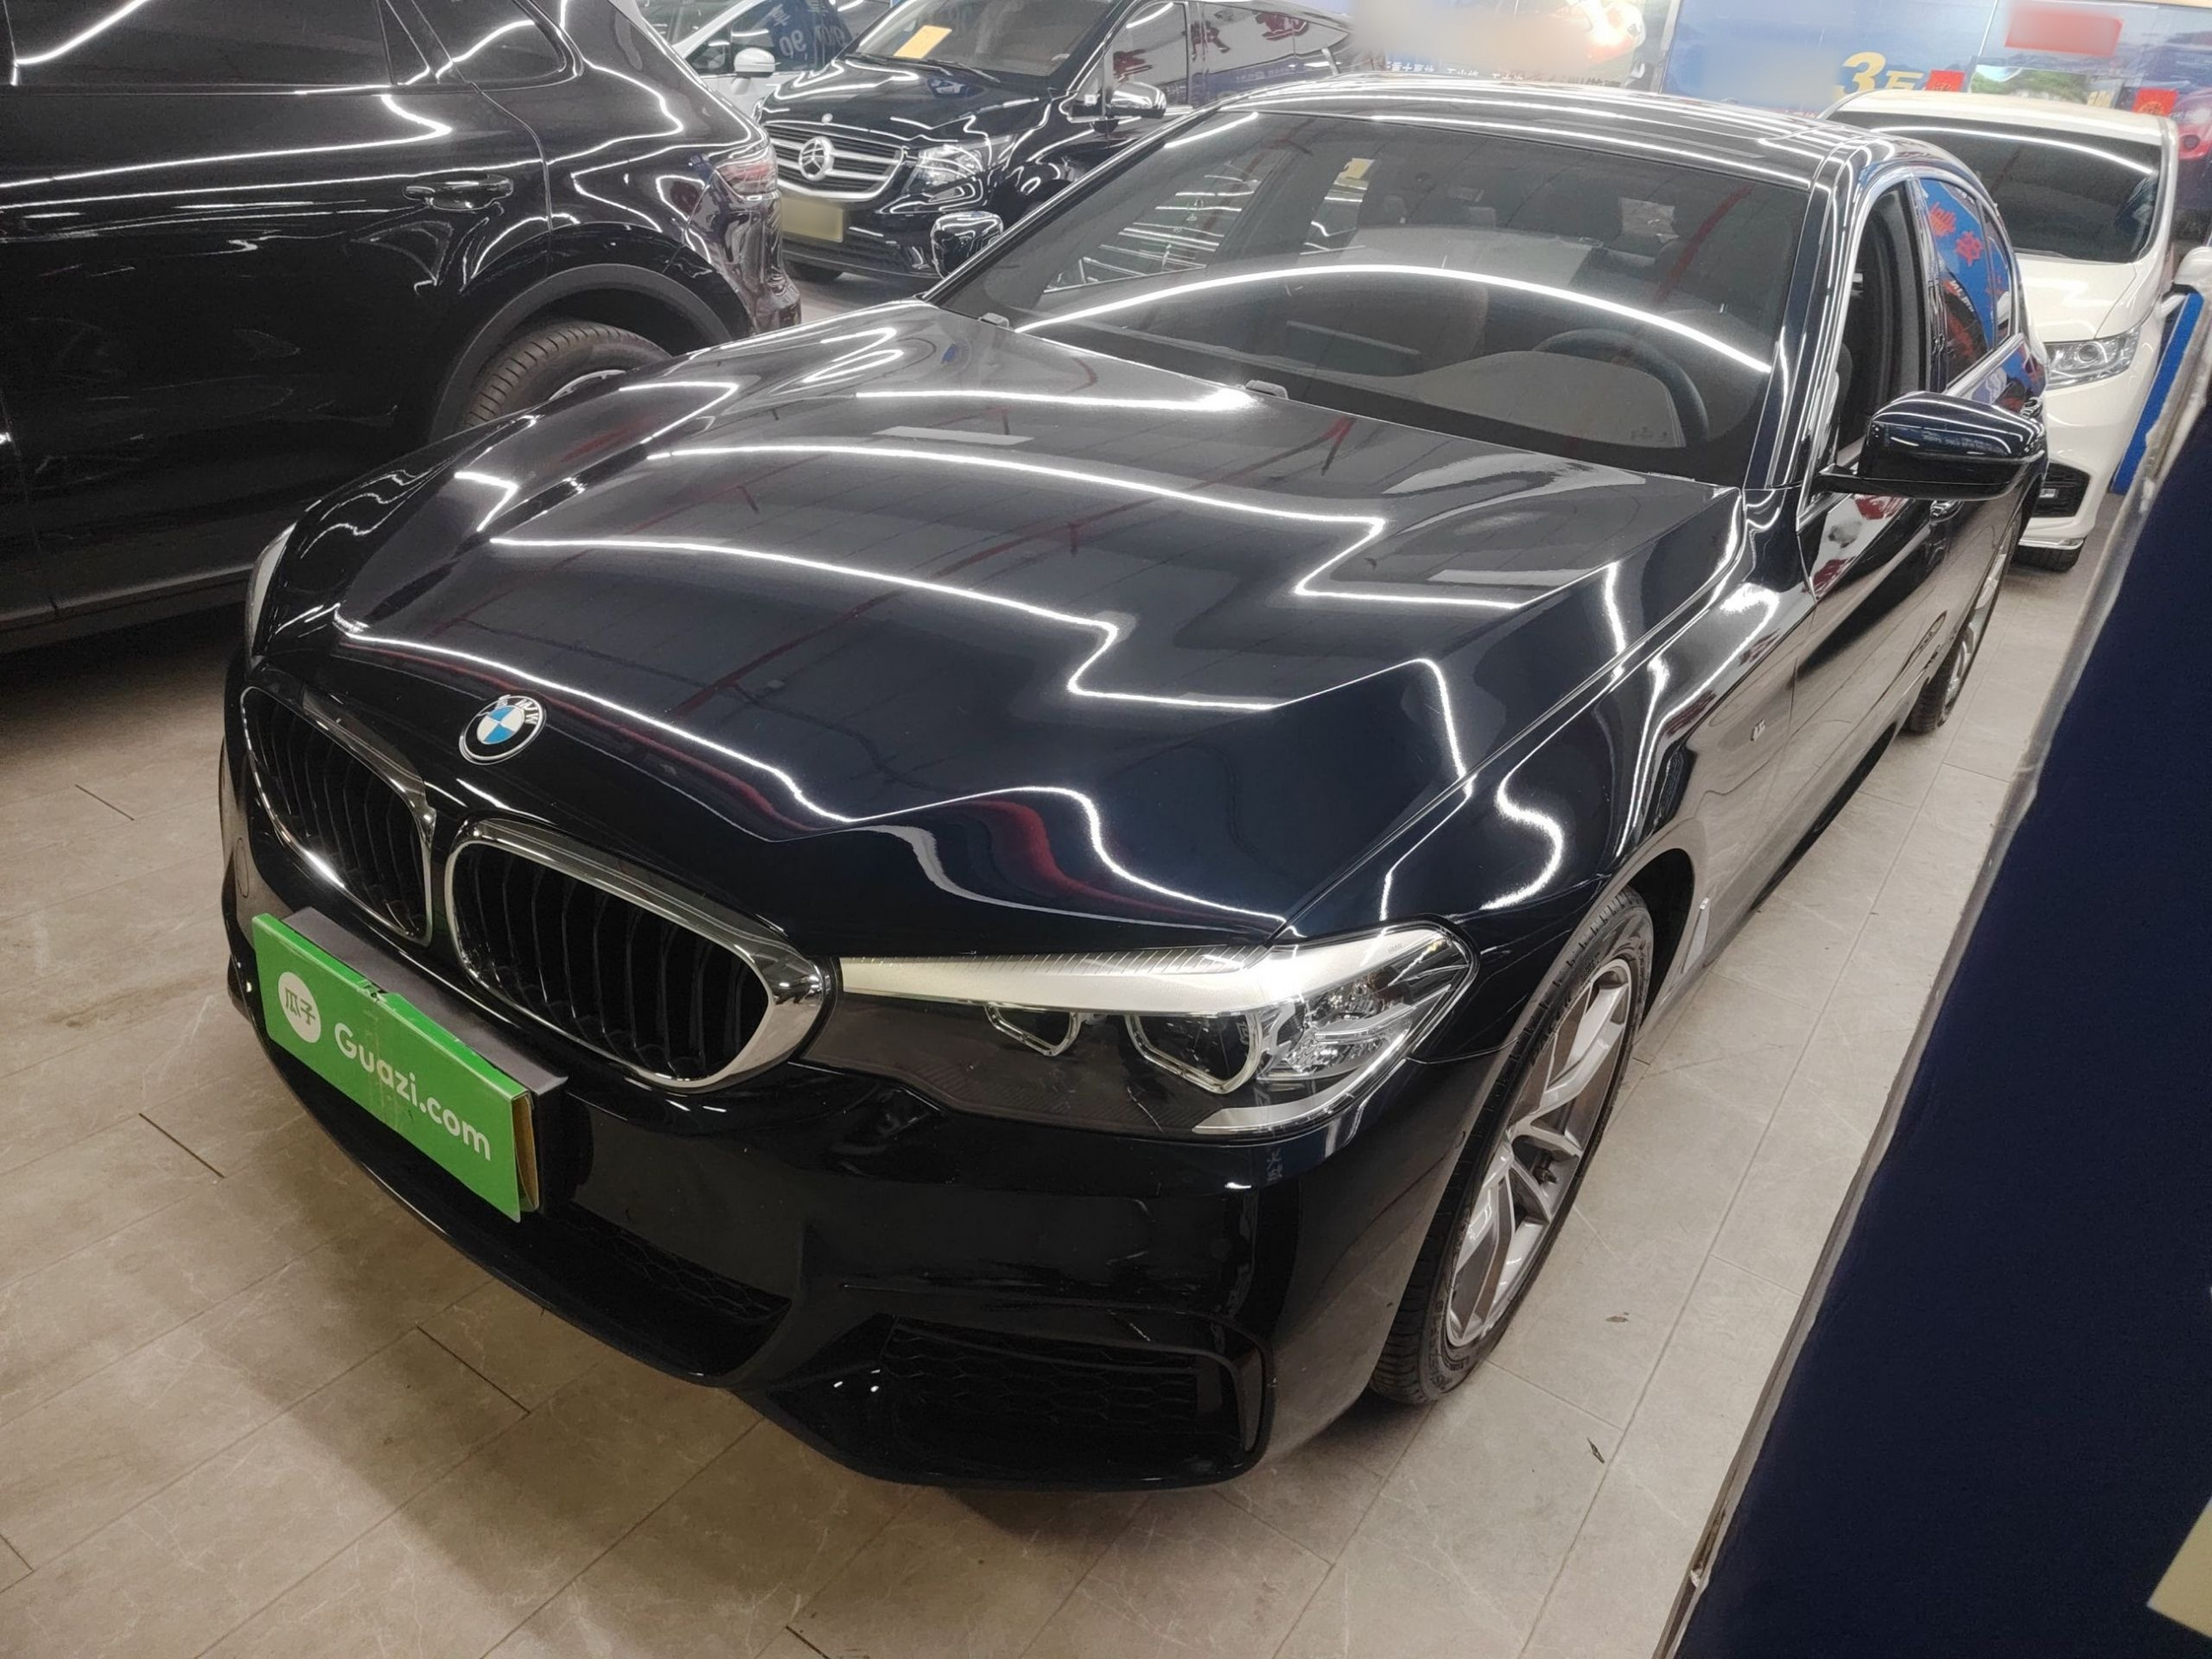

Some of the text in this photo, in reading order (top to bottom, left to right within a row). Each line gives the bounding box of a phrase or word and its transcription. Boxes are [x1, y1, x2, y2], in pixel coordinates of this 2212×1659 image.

[496, 697, 539, 725] BMW
[285, 986, 491, 1162] 瓜子 Guazi.com
